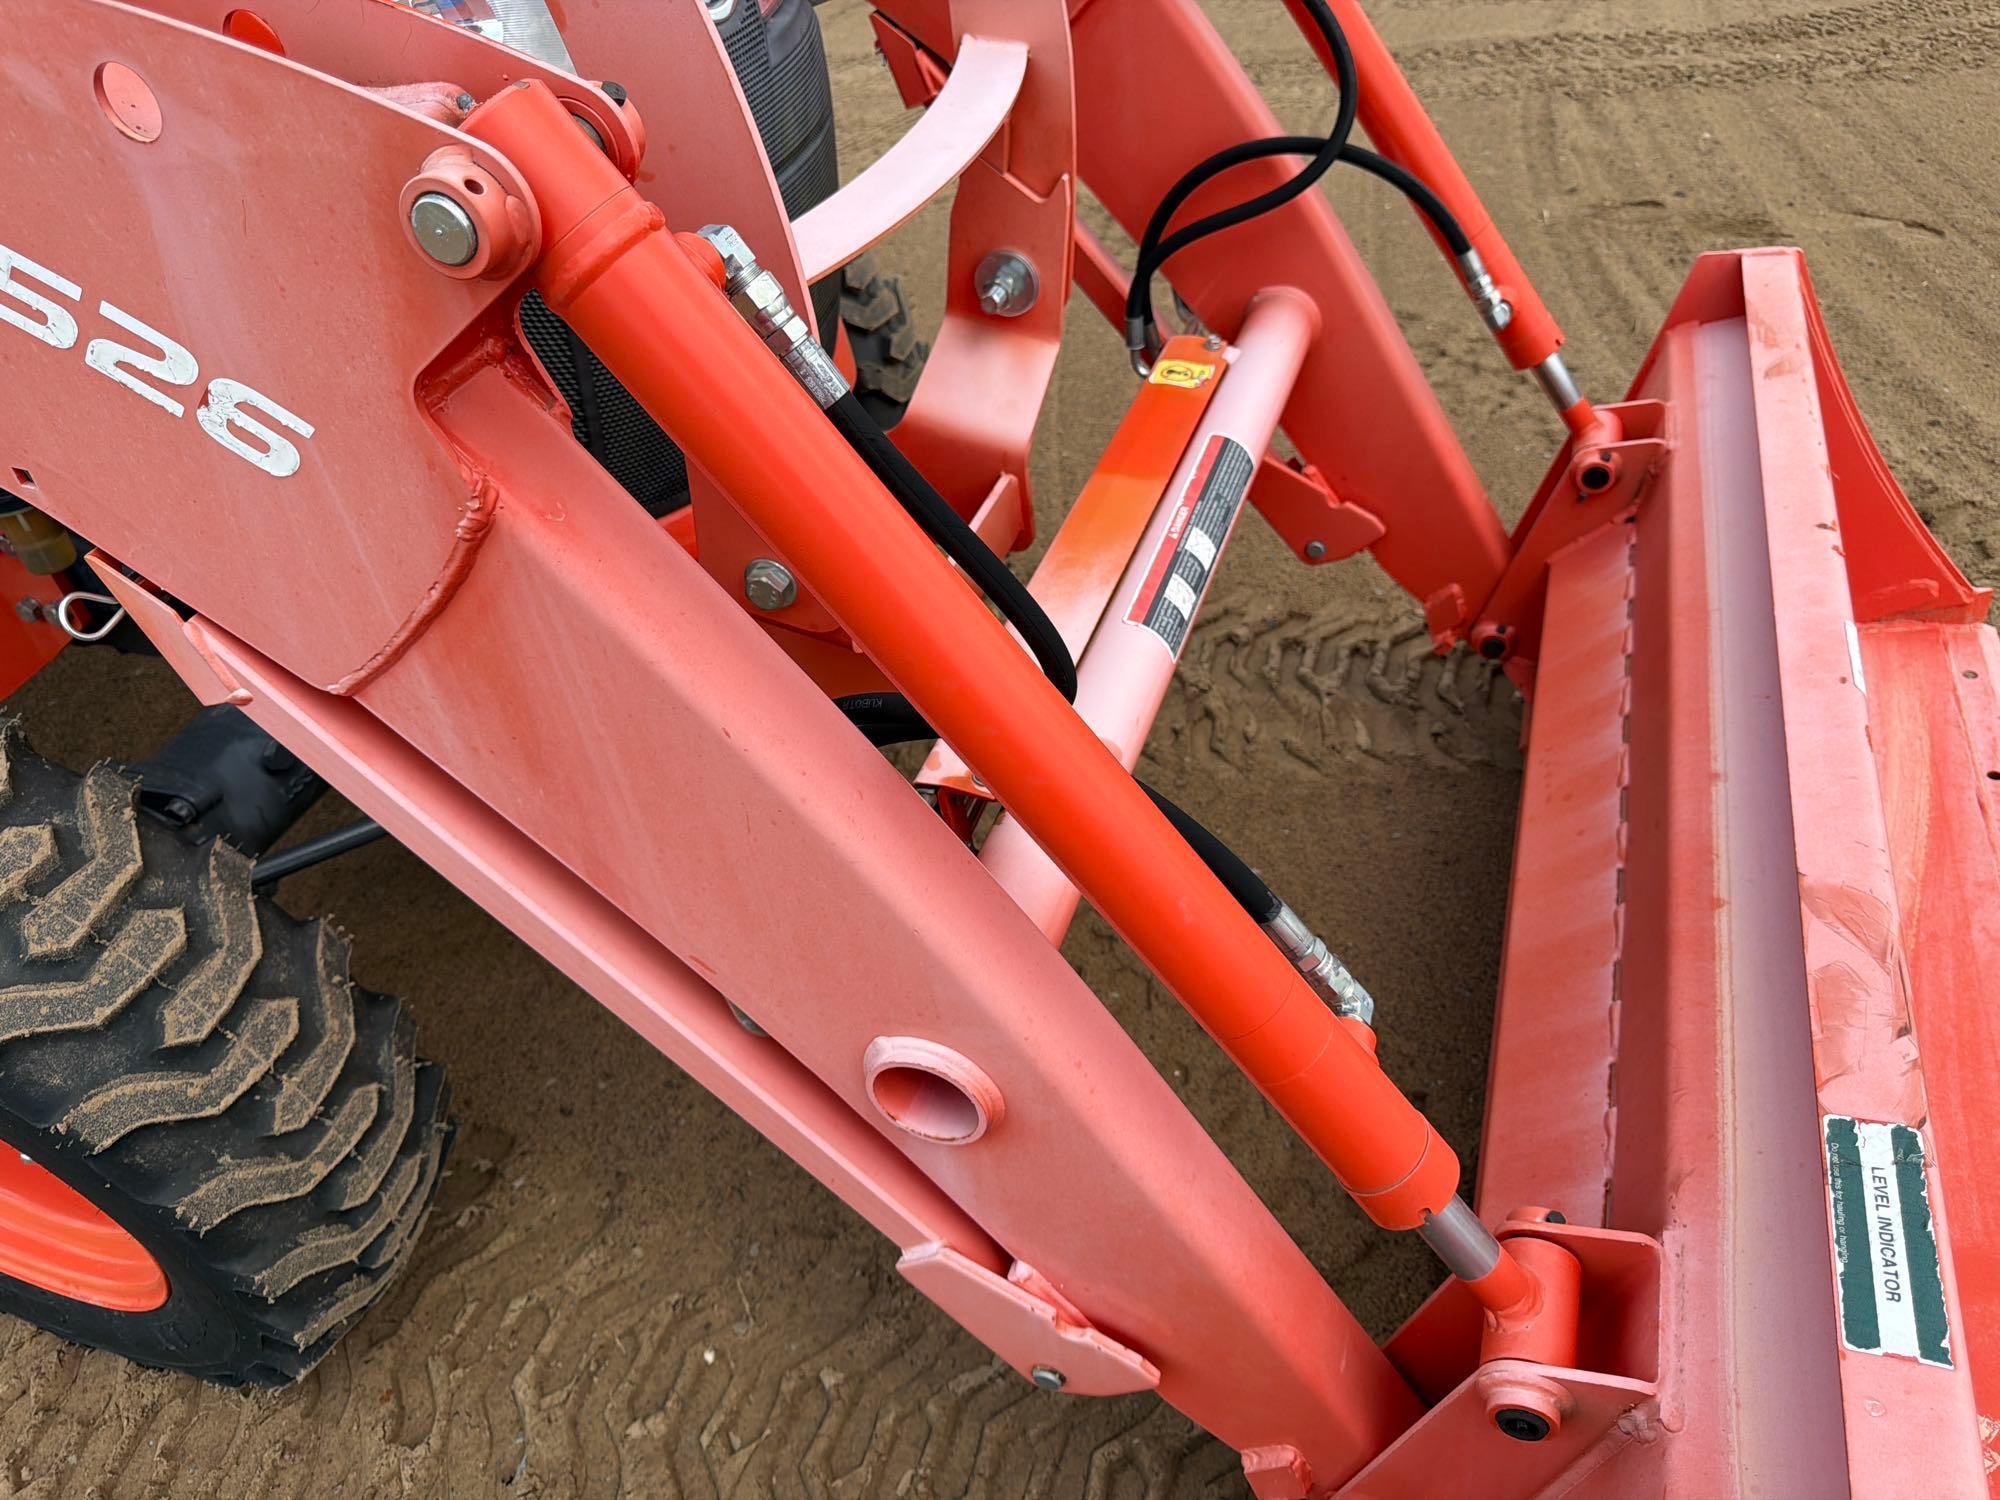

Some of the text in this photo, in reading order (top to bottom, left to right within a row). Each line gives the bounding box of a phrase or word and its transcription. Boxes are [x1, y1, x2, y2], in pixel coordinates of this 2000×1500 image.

[0, 243, 315, 478] 526
[1831, 1142, 1840, 1152] Do
[1832, 1152, 1840, 1164] not
[1834, 1177, 1842, 1190] this
[1835, 1190, 1844, 1200] for
[1836, 1200, 1846, 1226] hauling
[1838, 1226, 1846, 1235] or
[1871, 1166, 1901, 1303] LEVEL INDICATOR
